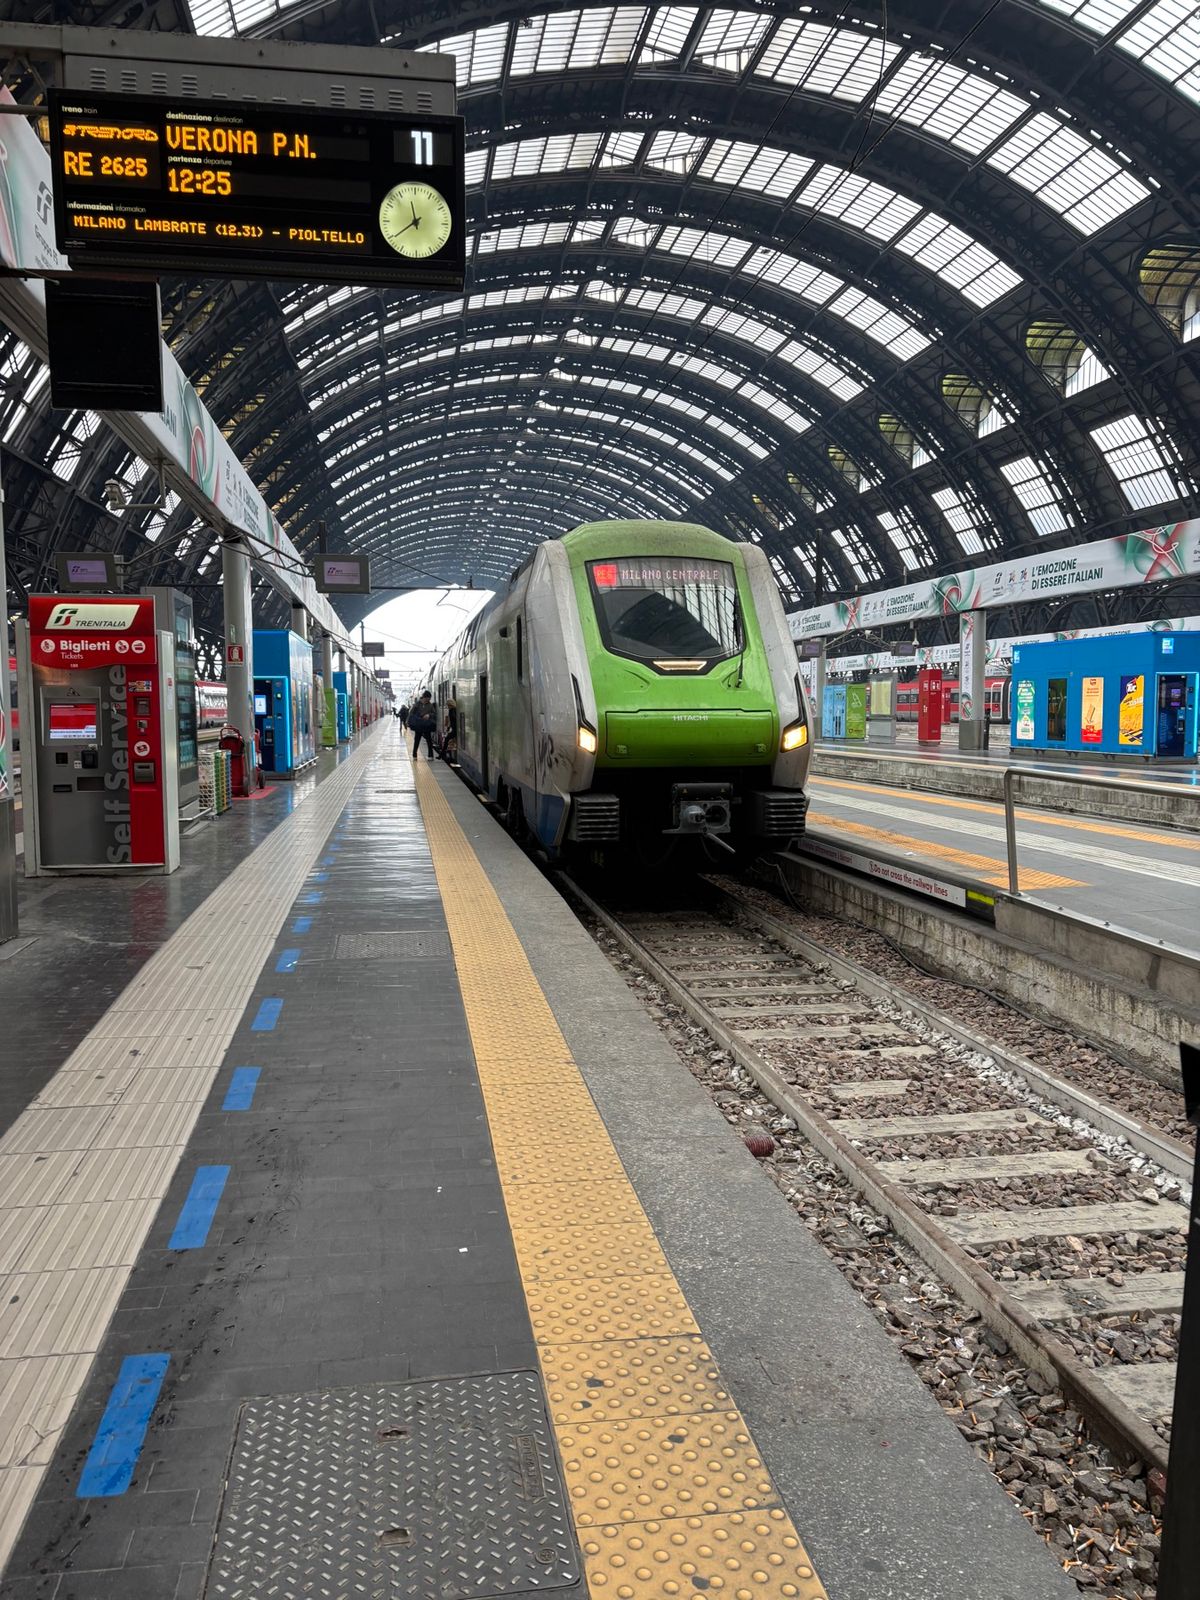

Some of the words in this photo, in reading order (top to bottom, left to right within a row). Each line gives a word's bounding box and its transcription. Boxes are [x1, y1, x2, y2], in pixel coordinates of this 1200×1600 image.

[62, 105, 82, 113] treno
[166, 111, 212, 122] destinazione
[213, 115, 243, 124] destination
[166, 125, 258, 155] VERONA
[273, 132, 317, 159] P.N.
[411, 130, 433, 166] 11
[64, 151, 93, 176] RE
[100, 156, 148, 177] 2625
[168, 155, 202, 164] partenza
[203, 158, 232, 166] departure
[168, 168, 232, 196] 12:25
[67, 201, 113, 211] informazioni
[115, 204, 146, 213] information
[73, 215, 126, 230] MILANO
[135, 219, 206, 235] LAMBRATE
[215, 224, 263, 238] (12.31)
[289, 228, 364, 244] PIOLTELLO
[621, 570, 662, 581] MILANO
[665, 569, 719, 581] CENTRALE
[1031, 558, 1077, 577] L'EMOZIONE
[1031, 579, 1040, 590] DI
[1040, 574, 1067, 589] ESSERE
[1067, 567, 1104, 584] ITALIANI
[886, 592, 915, 607] L'EMOZIONE
[75, 620, 126, 628] TRENITALIA
[60, 640, 111, 653] Biglietti
[61, 652, 84, 660] Tickets
[102, 665, 130, 791] Service
[104, 800, 132, 864] Self
[881, 868, 890, 877] not
[890, 871, 903, 881] cross
[903, 873, 912, 884] the
[913, 878, 933, 893] railway
[934, 883, 949, 897] lines
